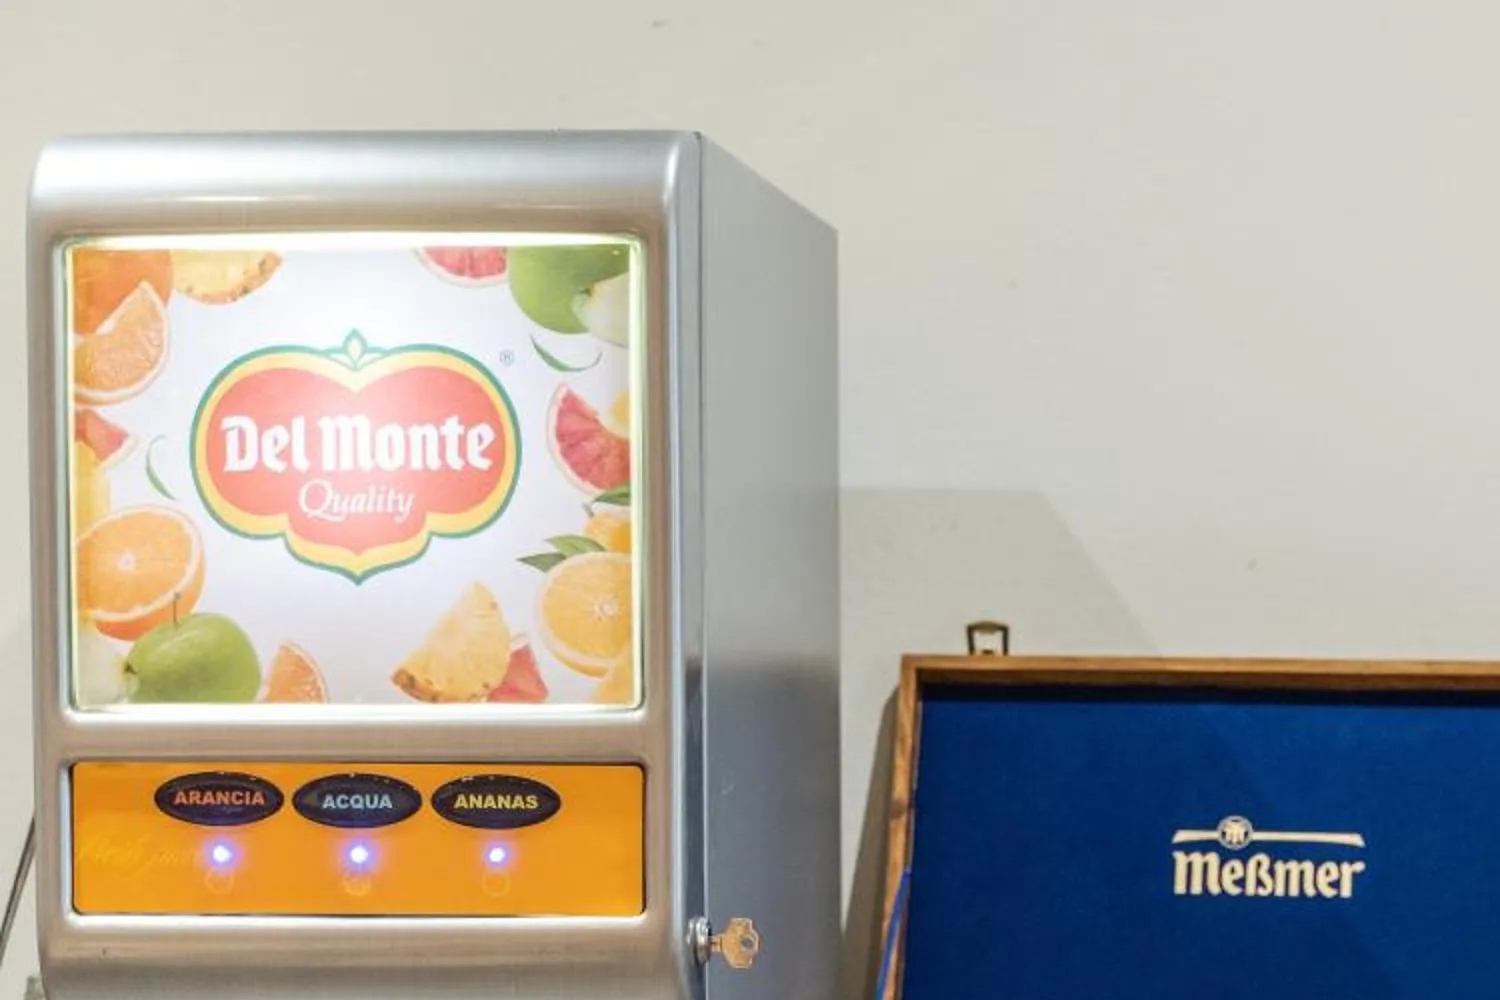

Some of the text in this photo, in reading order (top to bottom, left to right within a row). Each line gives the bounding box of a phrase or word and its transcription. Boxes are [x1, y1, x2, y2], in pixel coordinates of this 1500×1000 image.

[221, 413, 497, 473] Del Monte
[299, 478, 416, 524] Quality
[173, 788, 266, 807] ARANCIA
[321, 793, 393, 811] ACQUA
[452, 793, 540, 811] ANANAS
[1172, 851, 1366, 899] Meßmer
